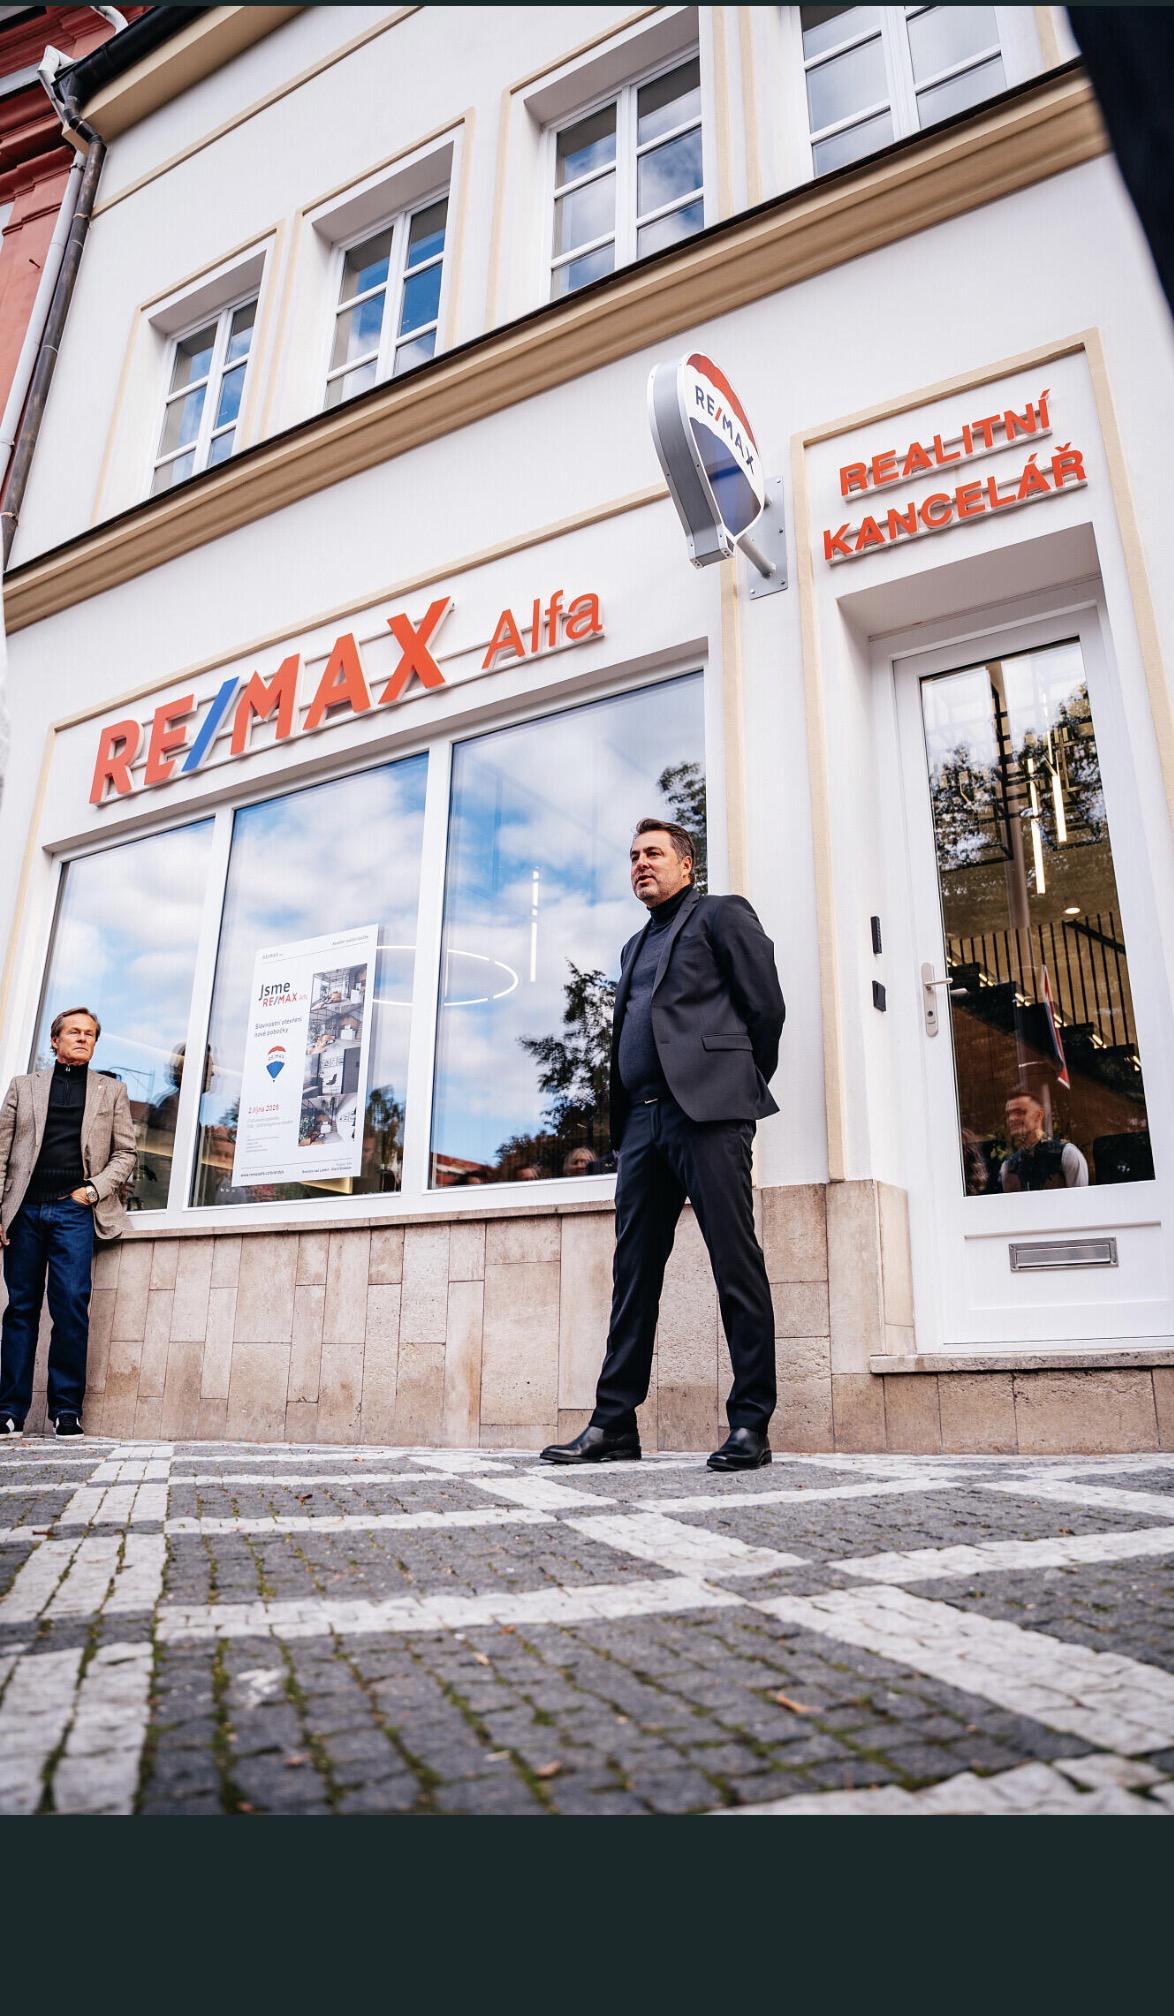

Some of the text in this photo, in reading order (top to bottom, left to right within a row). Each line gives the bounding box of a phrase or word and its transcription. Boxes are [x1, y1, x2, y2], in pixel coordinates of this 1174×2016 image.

[694, 384, 755, 476] RE/MAX
[840, 388, 1051, 497] REALITNÍ
[822, 441, 1088, 561] KANCELÁŘ
[89, 589, 603, 805] RE/MAX Alfa
[258, 982, 290, 1001] Jsme
[262, 992, 298, 1007] RE/MAX
